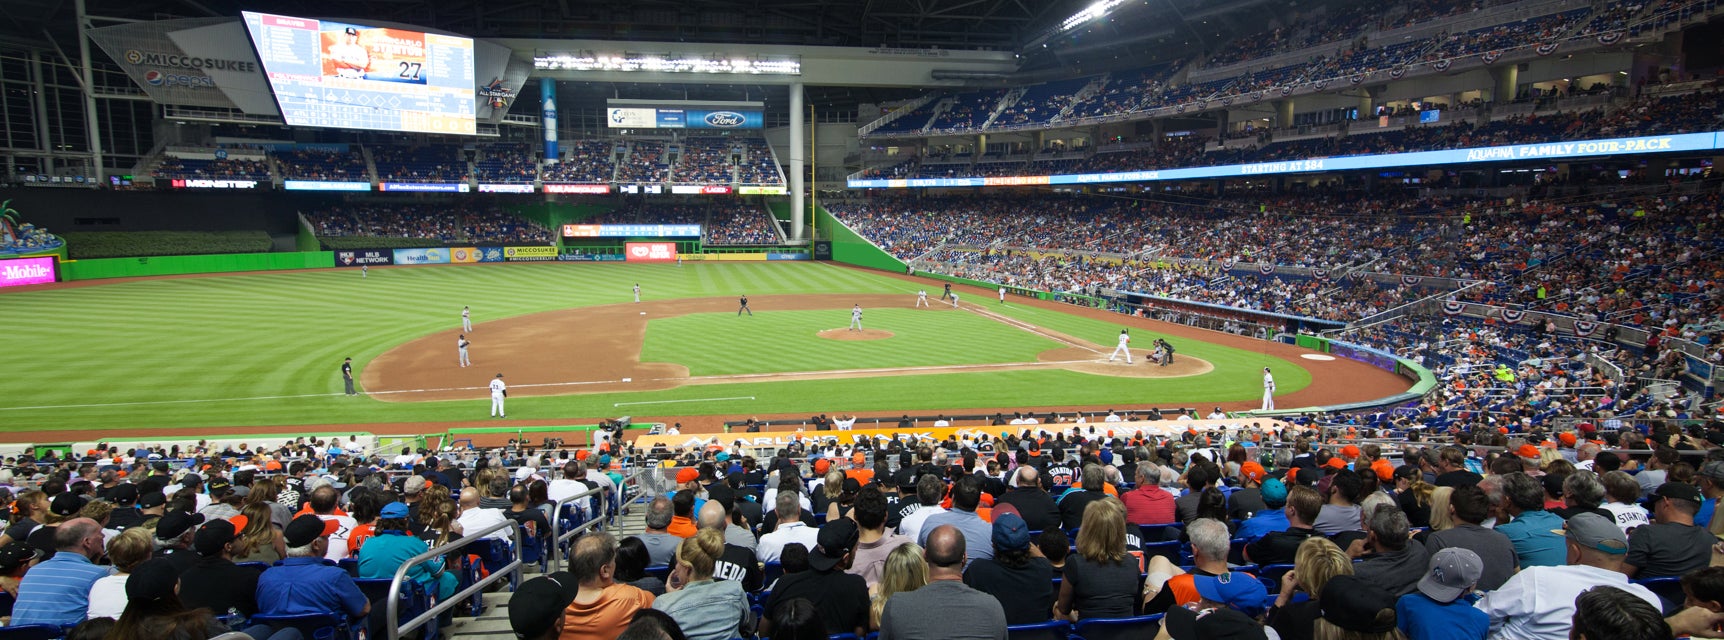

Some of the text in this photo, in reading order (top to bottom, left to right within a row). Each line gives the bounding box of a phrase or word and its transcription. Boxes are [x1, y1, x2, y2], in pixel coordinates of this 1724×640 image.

[146, 53, 255, 72] MICCOSUKEE
[399, 61, 421, 79] 27
[165, 73, 215, 88] pepsi
[712, 113, 737, 125] Ford
[1466, 138, 1672, 161] AQUAFINA FAMILY FOUR-PACK
[1241, 160, 1323, 174] STARTING AT $84
[185, 179, 255, 188] MONSTER
[681, 433, 840, 447] MARLNS
[1048, 467, 1073, 477] STANTON
[1053, 475, 1073, 486] 27
[1617, 511, 1650, 524] STANTON
[712, 560, 747, 582] NEDA
